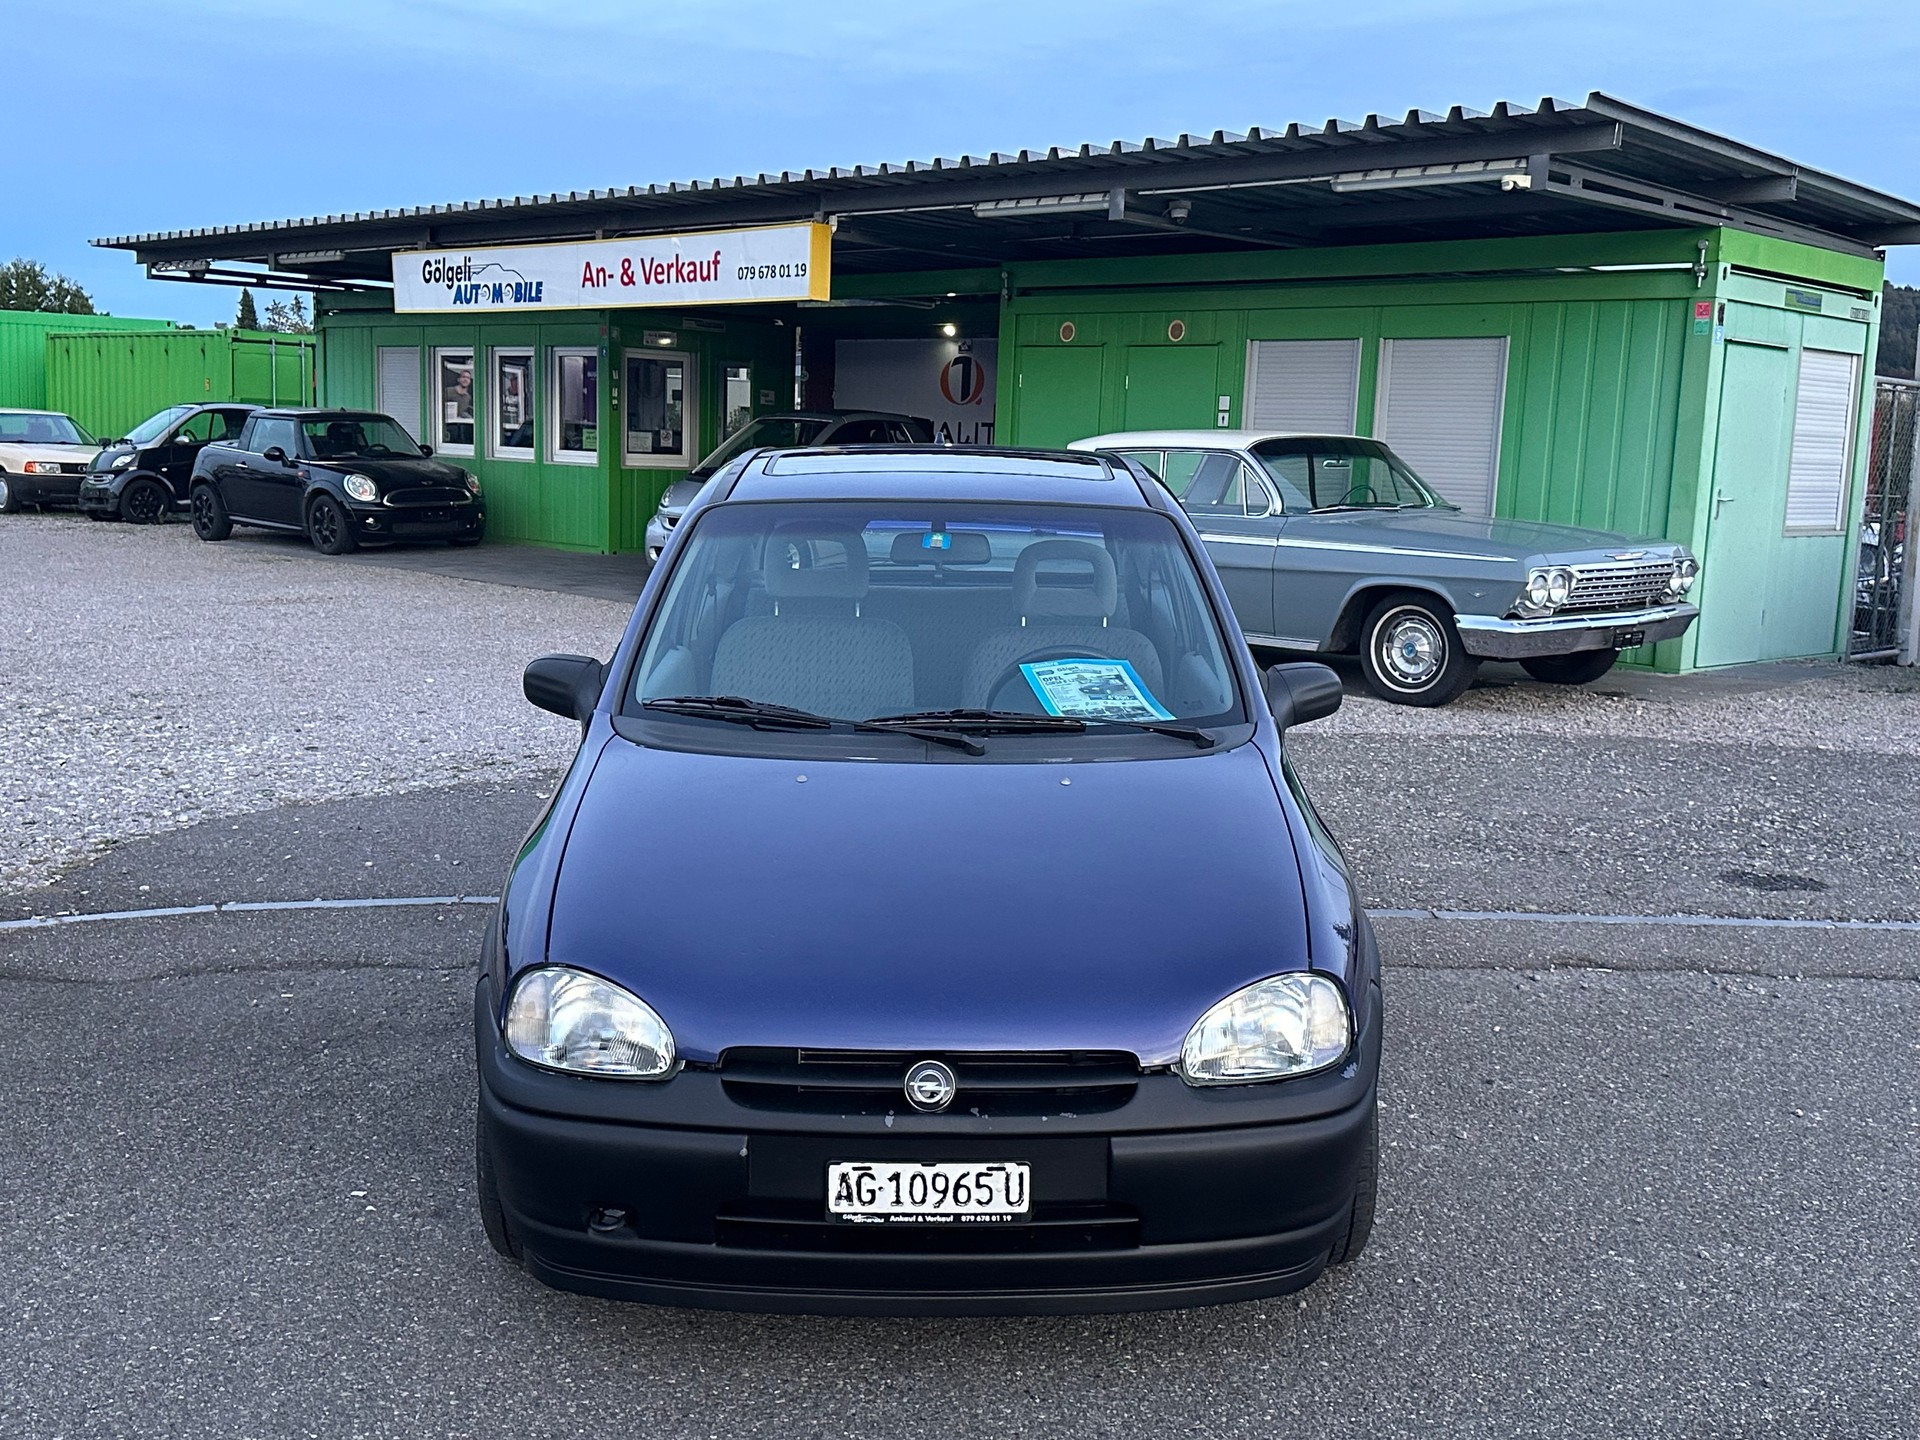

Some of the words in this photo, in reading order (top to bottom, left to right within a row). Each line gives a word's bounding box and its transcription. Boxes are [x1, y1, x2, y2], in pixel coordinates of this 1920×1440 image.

[422, 256, 472, 290] Gölgeli
[582, 261, 614, 288] An-
[620, 257, 636, 287] &
[640, 250, 721, 285] Verkauf
[737, 266, 756, 280] 079
[758, 265, 777, 279] 678
[779, 264, 791, 278] 01
[794, 263, 807, 277] 19
[453, 281, 543, 304] AUTOMOBILE
